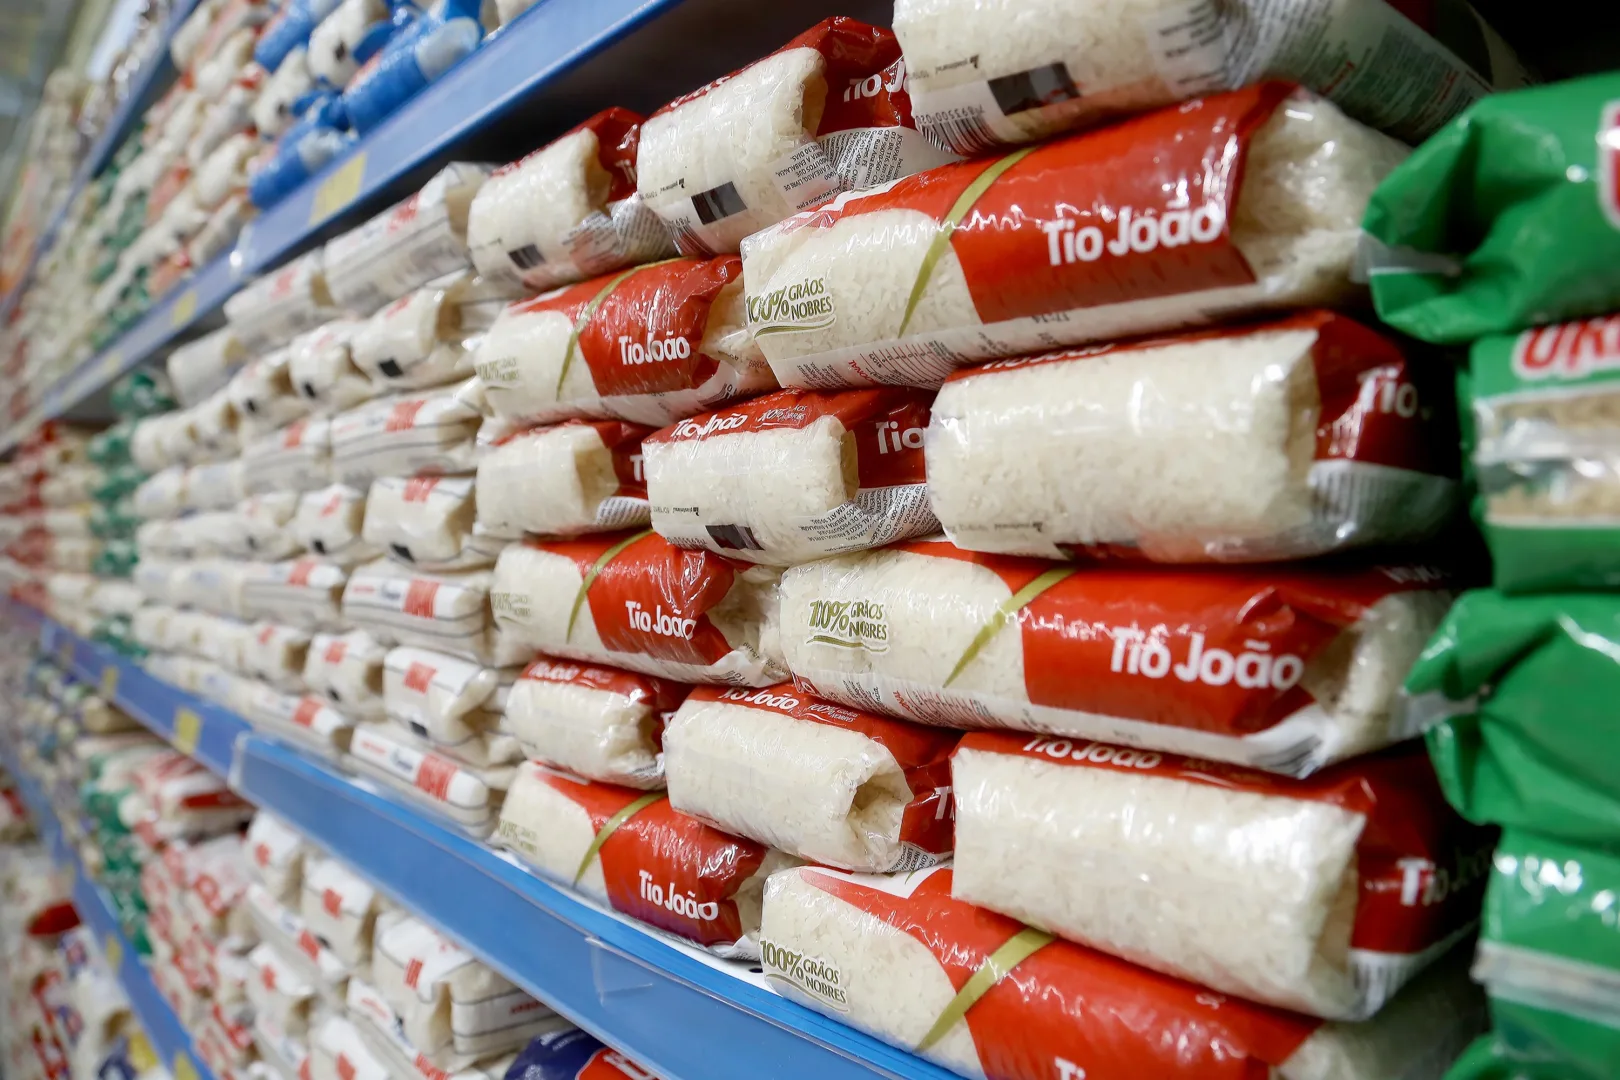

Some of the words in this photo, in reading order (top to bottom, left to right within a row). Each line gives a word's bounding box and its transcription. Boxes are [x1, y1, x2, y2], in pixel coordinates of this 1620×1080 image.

[1043, 219, 1104, 265] Tio
[1107, 204, 1226, 256] João
[746, 286, 790, 322] 100%
[788, 278, 824, 302] GRÃOS
[791, 296, 832, 320] NOBRES
[618, 336, 644, 365] Tio
[645, 330, 690, 363] João
[670, 418, 697, 438] Tio
[876, 421, 924, 454] Tio
[626, 600, 651, 632] Tio
[652, 605, 696, 640] João
[809, 600, 851, 632] 100%
[850, 599, 884, 620] GRÃOS
[848, 620, 886, 640] NOBRES
[1110, 626, 1170, 678] Tio
[1174, 632, 1304, 690] João
[744, 690, 800, 710] João
[638, 870, 663, 906] Tio
[664, 882, 718, 920] João
[760, 940, 804, 980] 100%
[803, 959, 840, 984] GRÃOS
[806, 976, 846, 1004] NOBRES
